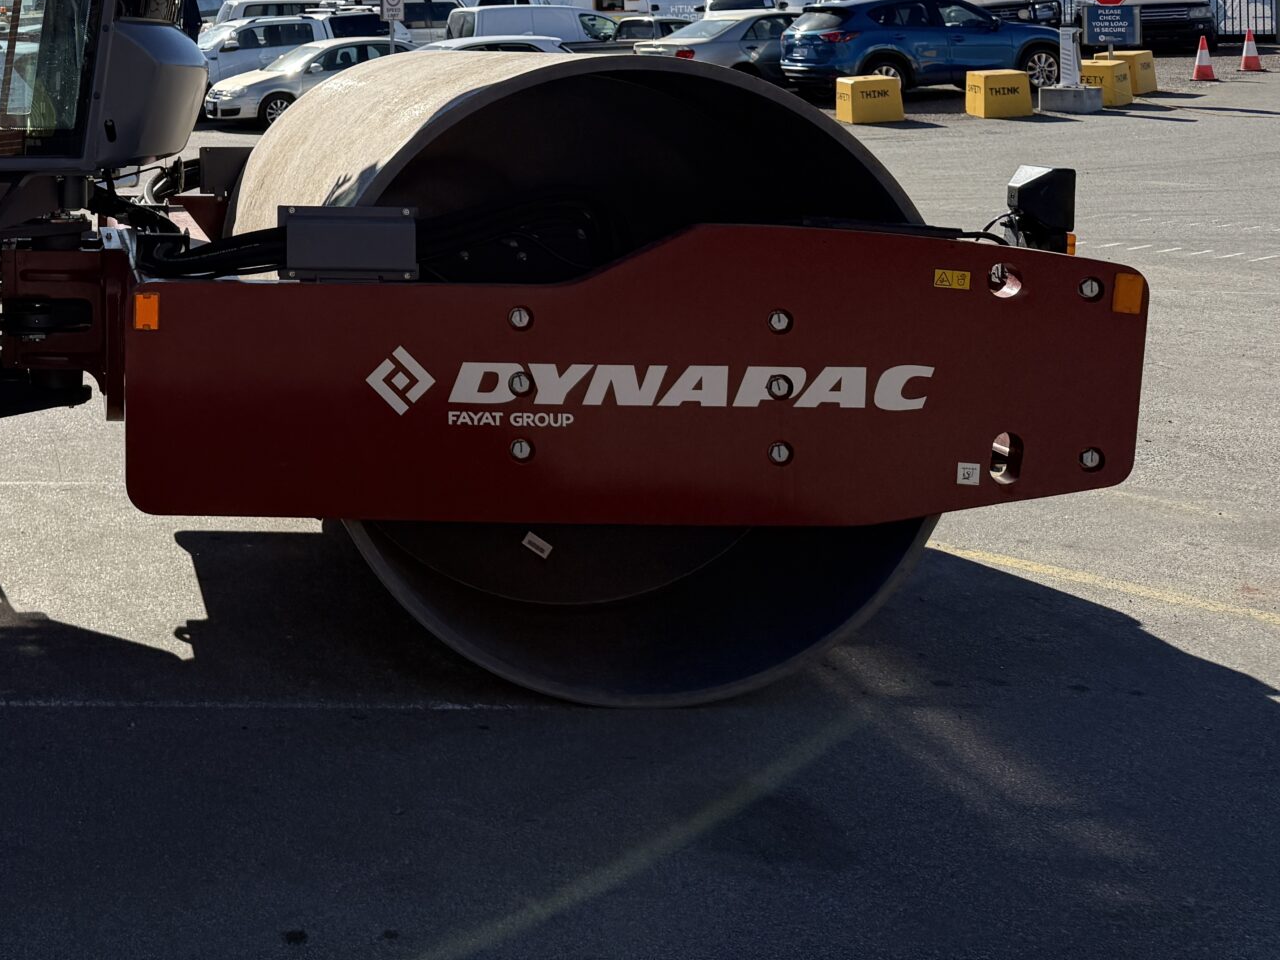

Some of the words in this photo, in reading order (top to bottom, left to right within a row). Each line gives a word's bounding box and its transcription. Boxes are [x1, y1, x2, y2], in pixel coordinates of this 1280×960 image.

[1080, 76, 1104, 84] FETY
[860, 89, 890, 99] THINK
[989, 86, 1020, 96] THINK
[448, 362, 935, 411] DYNAPAC
[448, 410, 504, 426] FAYAT
[510, 412, 574, 427] GROUP
